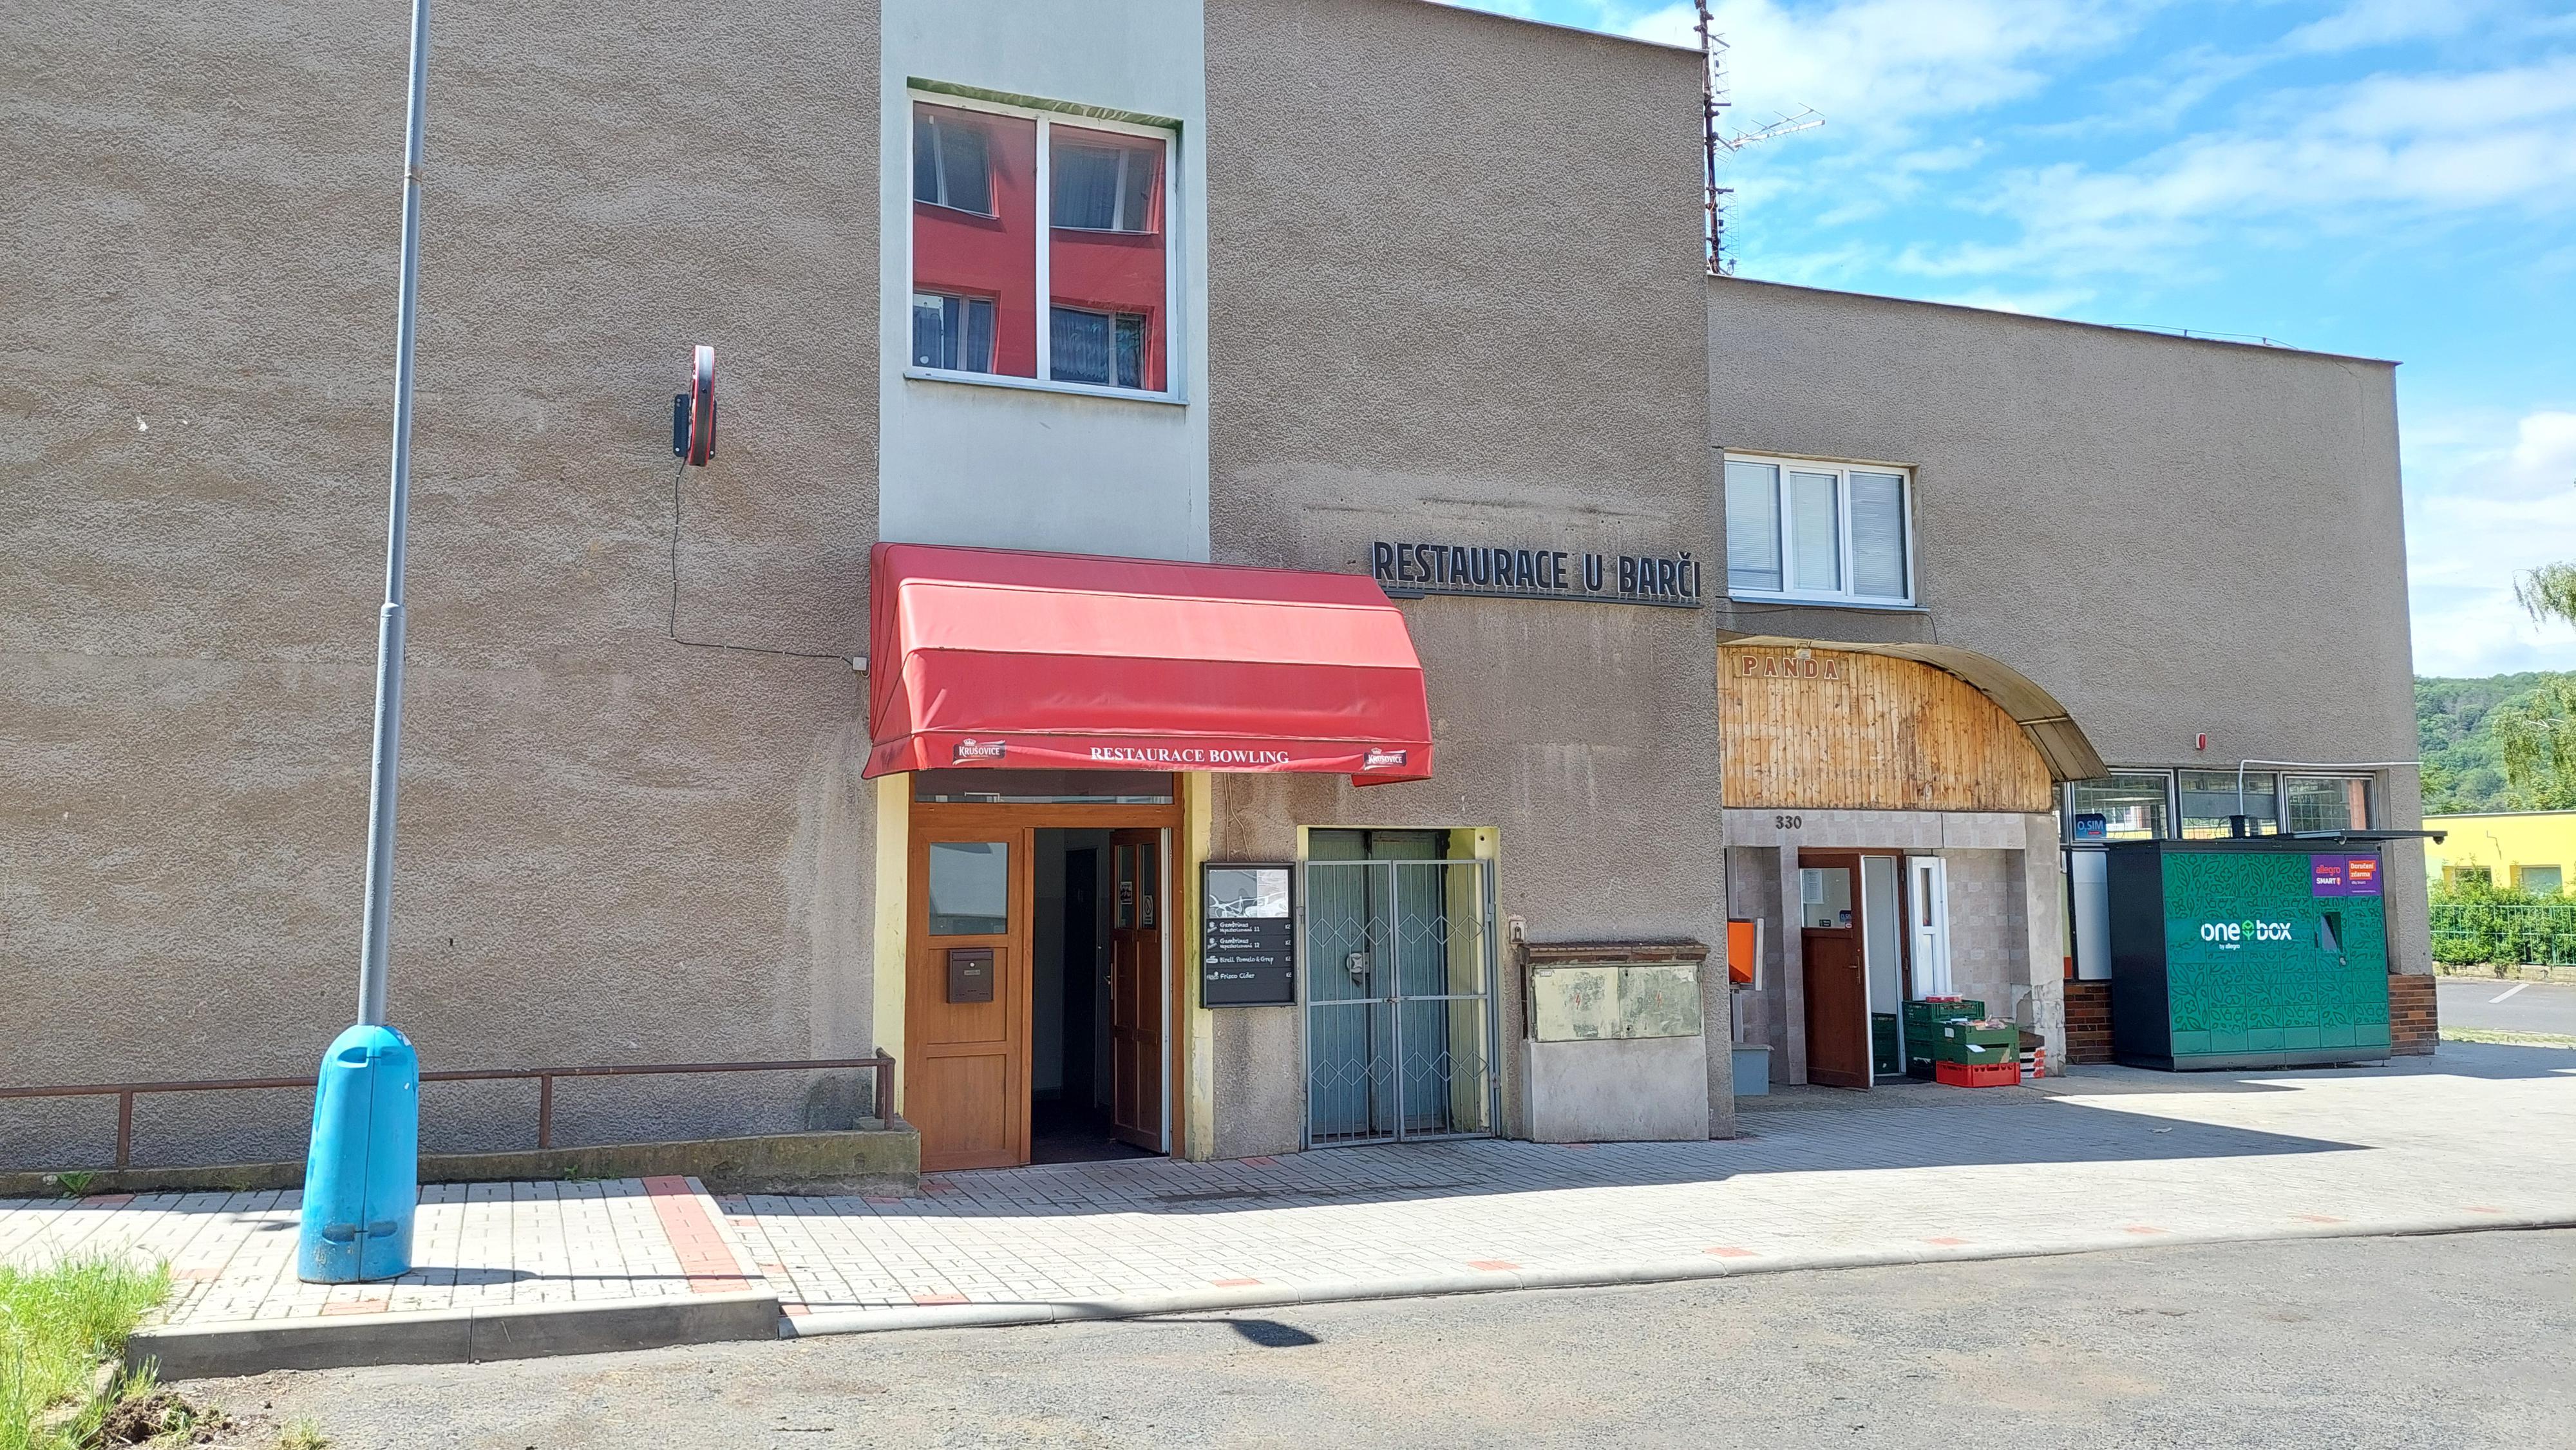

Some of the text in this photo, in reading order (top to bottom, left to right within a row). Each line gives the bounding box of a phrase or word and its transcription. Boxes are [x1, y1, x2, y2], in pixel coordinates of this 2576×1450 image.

[1372, 541, 1701, 598] RESTAURACE U BARČI
[1742, 655, 1839, 680] PANDA
[958, 746, 1000, 757] KRUŠOVICE
[1090, 747, 1289, 764] RESTAURACE BOWLING
[1776, 815, 1803, 829] 330
[2087, 820, 2103, 830] SIM
[2316, 865, 2341, 876] allegro
[2201, 919, 2293, 941] one box
